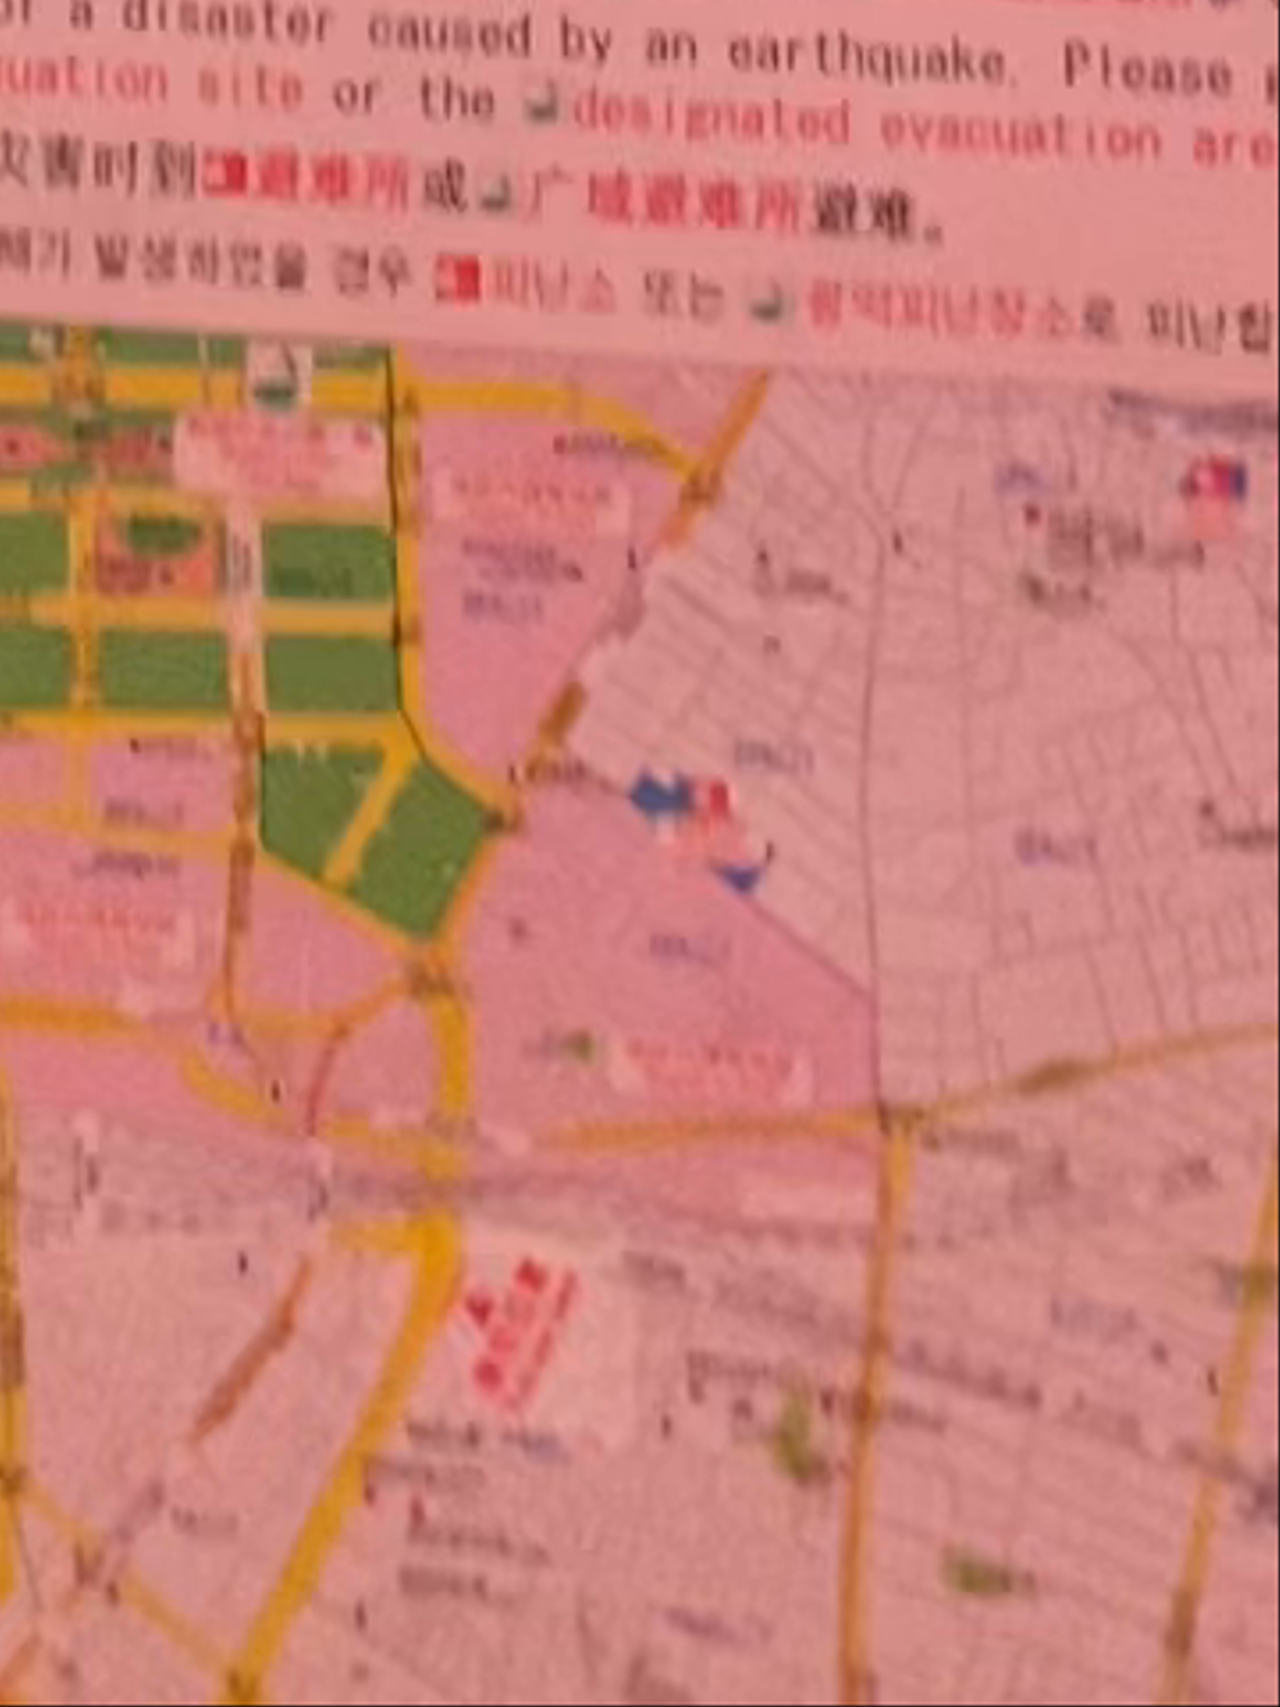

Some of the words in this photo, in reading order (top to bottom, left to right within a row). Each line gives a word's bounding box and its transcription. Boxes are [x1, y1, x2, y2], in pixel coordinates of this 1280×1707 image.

[367, 11, 532, 60] caused
[559, 13, 612, 66] by
[646, 27, 698, 66] an
[1064, 34, 1234, 97] Please
[197, 64, 305, 114] site
[333, 76, 380, 115] or
[420, 74, 496, 122] the
[574, 87, 851, 144] designated
[880, 108, 1163, 159] evacuation
